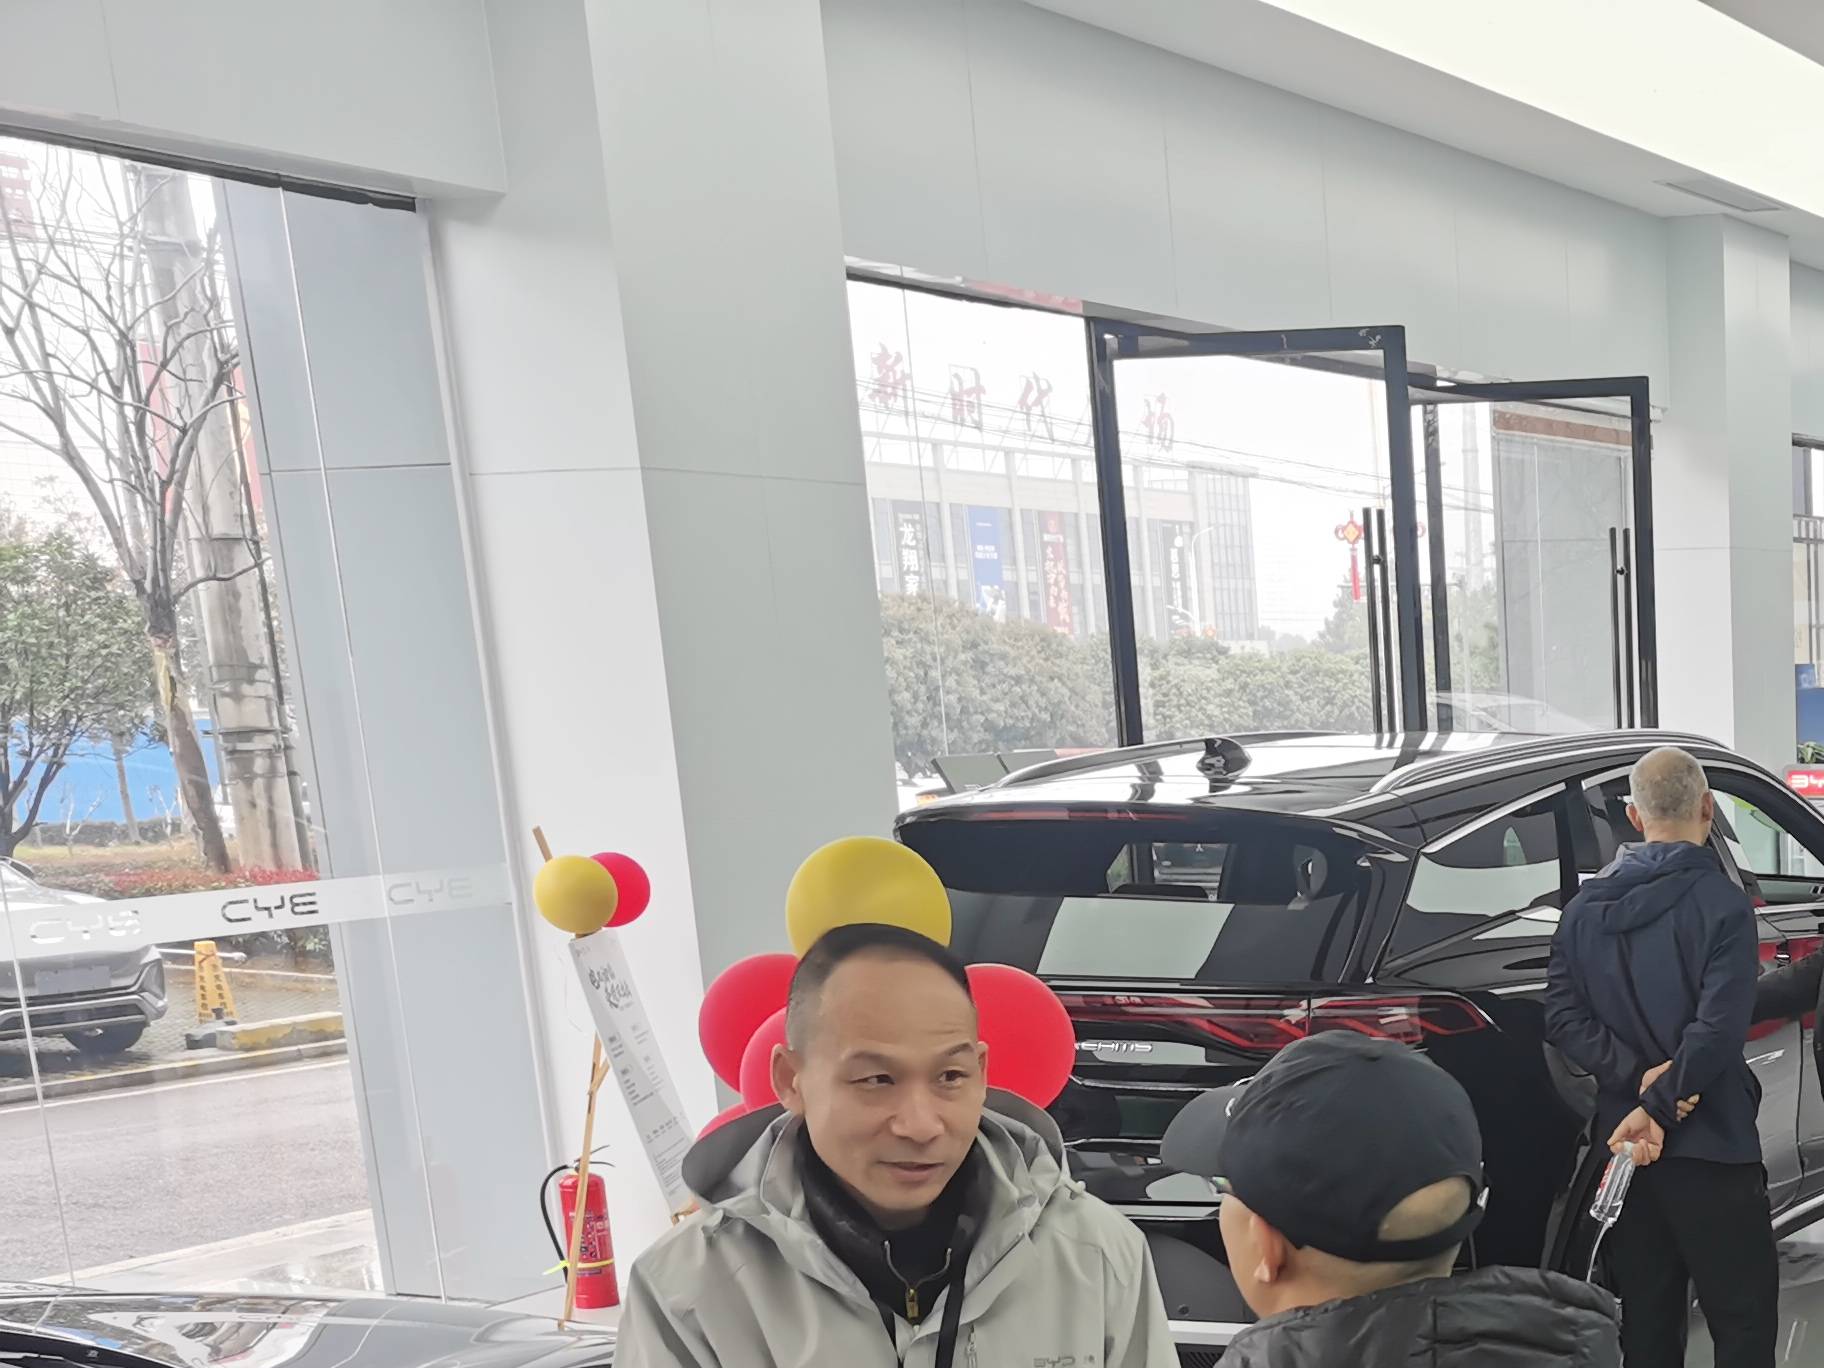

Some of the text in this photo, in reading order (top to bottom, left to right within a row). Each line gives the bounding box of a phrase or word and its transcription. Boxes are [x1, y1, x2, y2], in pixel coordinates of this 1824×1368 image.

[868, 342, 1174, 453] 新时代场
[1075, 1041, 1153, 1053] EAMS
[1033, 1356, 1076, 1368] BYD
